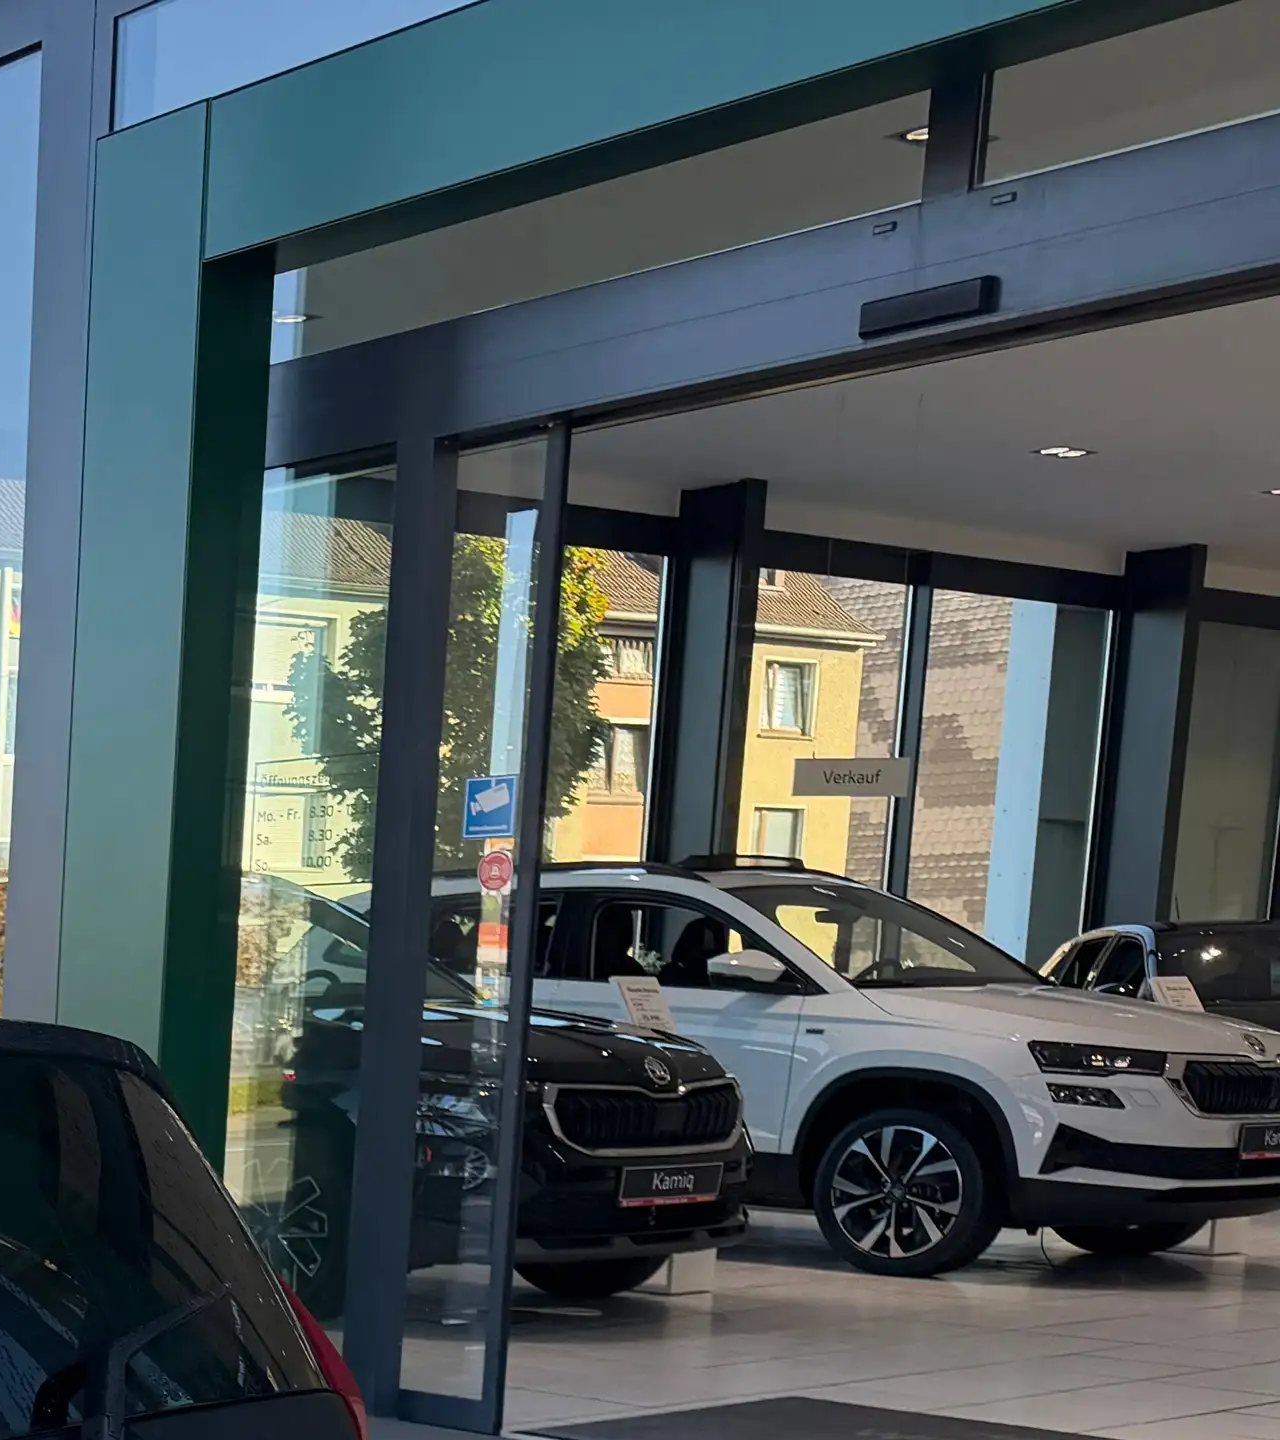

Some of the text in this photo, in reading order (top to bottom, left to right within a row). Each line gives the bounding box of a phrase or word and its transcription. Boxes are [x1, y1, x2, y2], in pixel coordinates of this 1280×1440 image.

[823, 769, 883, 784] Verkauf
[287, 809, 301, 820] Fr.
[652, 1170, 695, 1192] Kamiq
